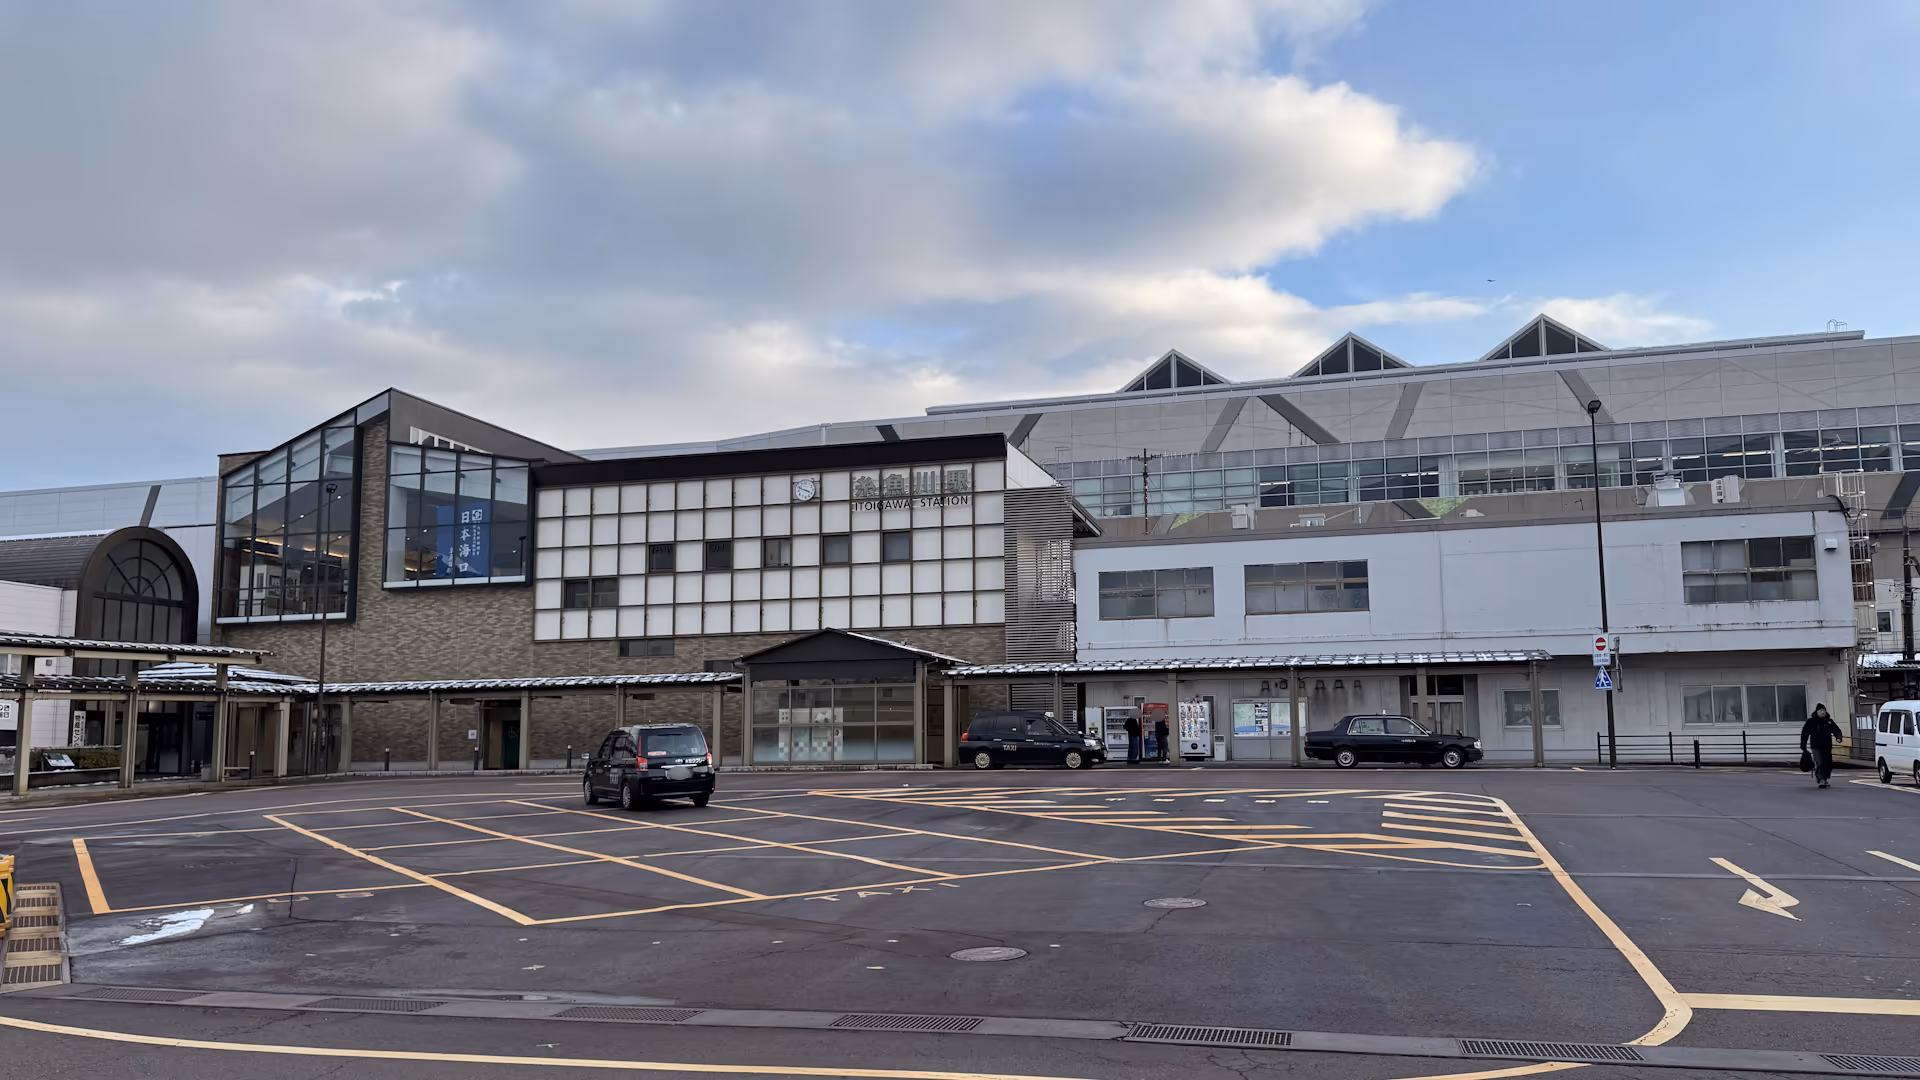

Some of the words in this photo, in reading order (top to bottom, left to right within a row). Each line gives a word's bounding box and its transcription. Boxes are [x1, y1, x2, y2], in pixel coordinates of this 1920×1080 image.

[855, 470, 969, 498] 糸魚川駅
[855, 500, 912, 511] ITOIGAWA
[920, 495, 968, 508] STATION
[459, 511, 471, 573] 日本海口
[803, 882, 961, 902] TAXI
